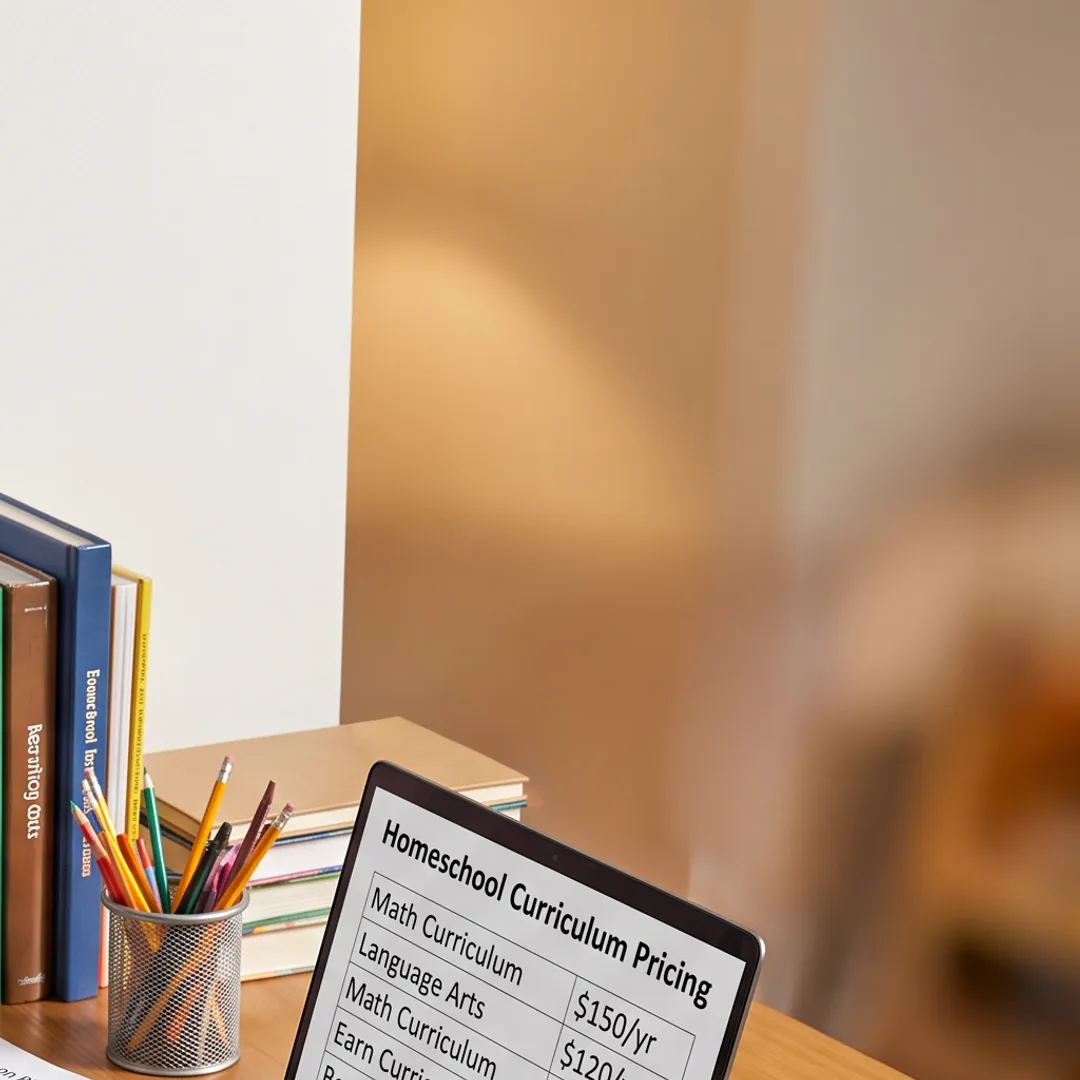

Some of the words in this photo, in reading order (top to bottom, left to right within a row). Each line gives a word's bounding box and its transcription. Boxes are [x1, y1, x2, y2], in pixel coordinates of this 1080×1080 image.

[382, 819, 507, 901] Homeschool
[510, 883, 627, 962] Curriculum
[632, 941, 712, 1009] Pricing
[359, 932, 442, 998] Language
[445, 982, 485, 1019] Arts
[371, 887, 417, 930] Math
[423, 915, 523, 986] Curriculum
[574, 991, 657, 1055] $150/yr
[334, 1021, 374, 1064] Earn
[346, 977, 392, 1021] Math
[398, 1006, 497, 1080] Curriculum
